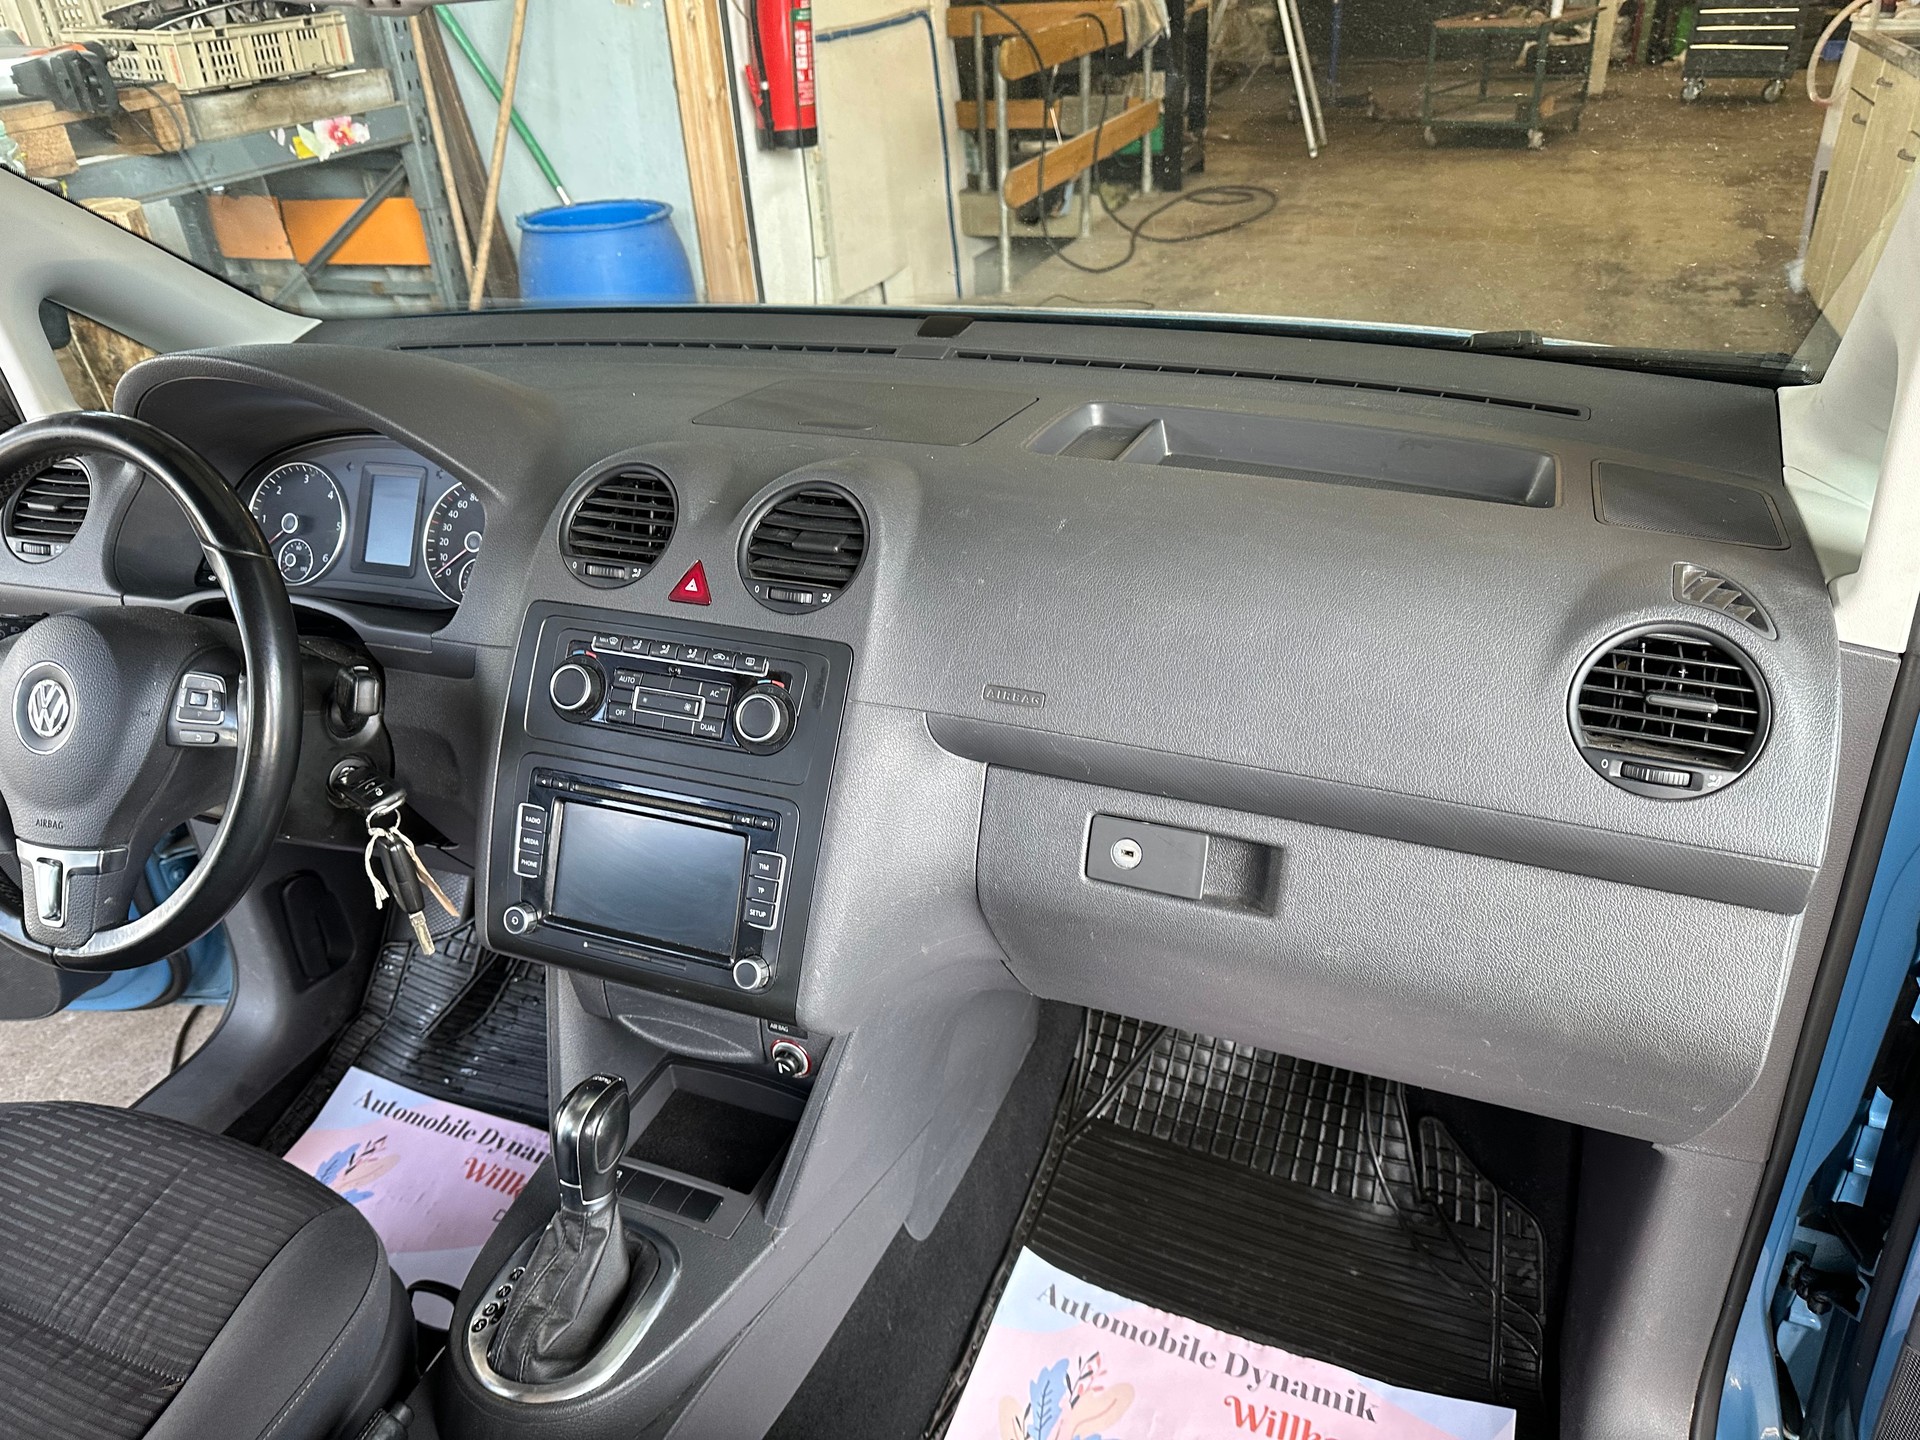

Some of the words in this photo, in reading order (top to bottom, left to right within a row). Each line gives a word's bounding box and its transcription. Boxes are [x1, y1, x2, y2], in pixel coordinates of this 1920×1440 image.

[303, 474, 309, 484] 3
[276, 485, 282, 495] 2
[327, 490, 334, 500] 4
[457, 500, 468, 509] 60
[448, 510, 459, 519] 40
[442, 523, 452, 532] 30
[439, 537, 449, 546] 20
[322, 553, 329, 563] 6
[440, 553, 448, 561] 10
[445, 567, 452, 576] 0
[618, 675, 636, 684] AUTO
[709, 690, 719, 698] AC
[986, 688, 1040, 704] AIRBAG
[615, 708, 626, 717] OFF
[700, 723, 717, 733] DUAL
[35, 818, 64, 830] AIRBAG
[525, 815, 541, 825] RADIO
[523, 836, 539, 846] MEDIA
[520, 858, 538, 868] PHONE
[759, 862, 770, 871] TIM
[749, 908, 767, 918] SETUP
[353, 1089, 477, 1142] Automobile
[1037, 1283, 1217, 1370] Automobile
[1224, 1350, 1379, 1424] Dynamik
